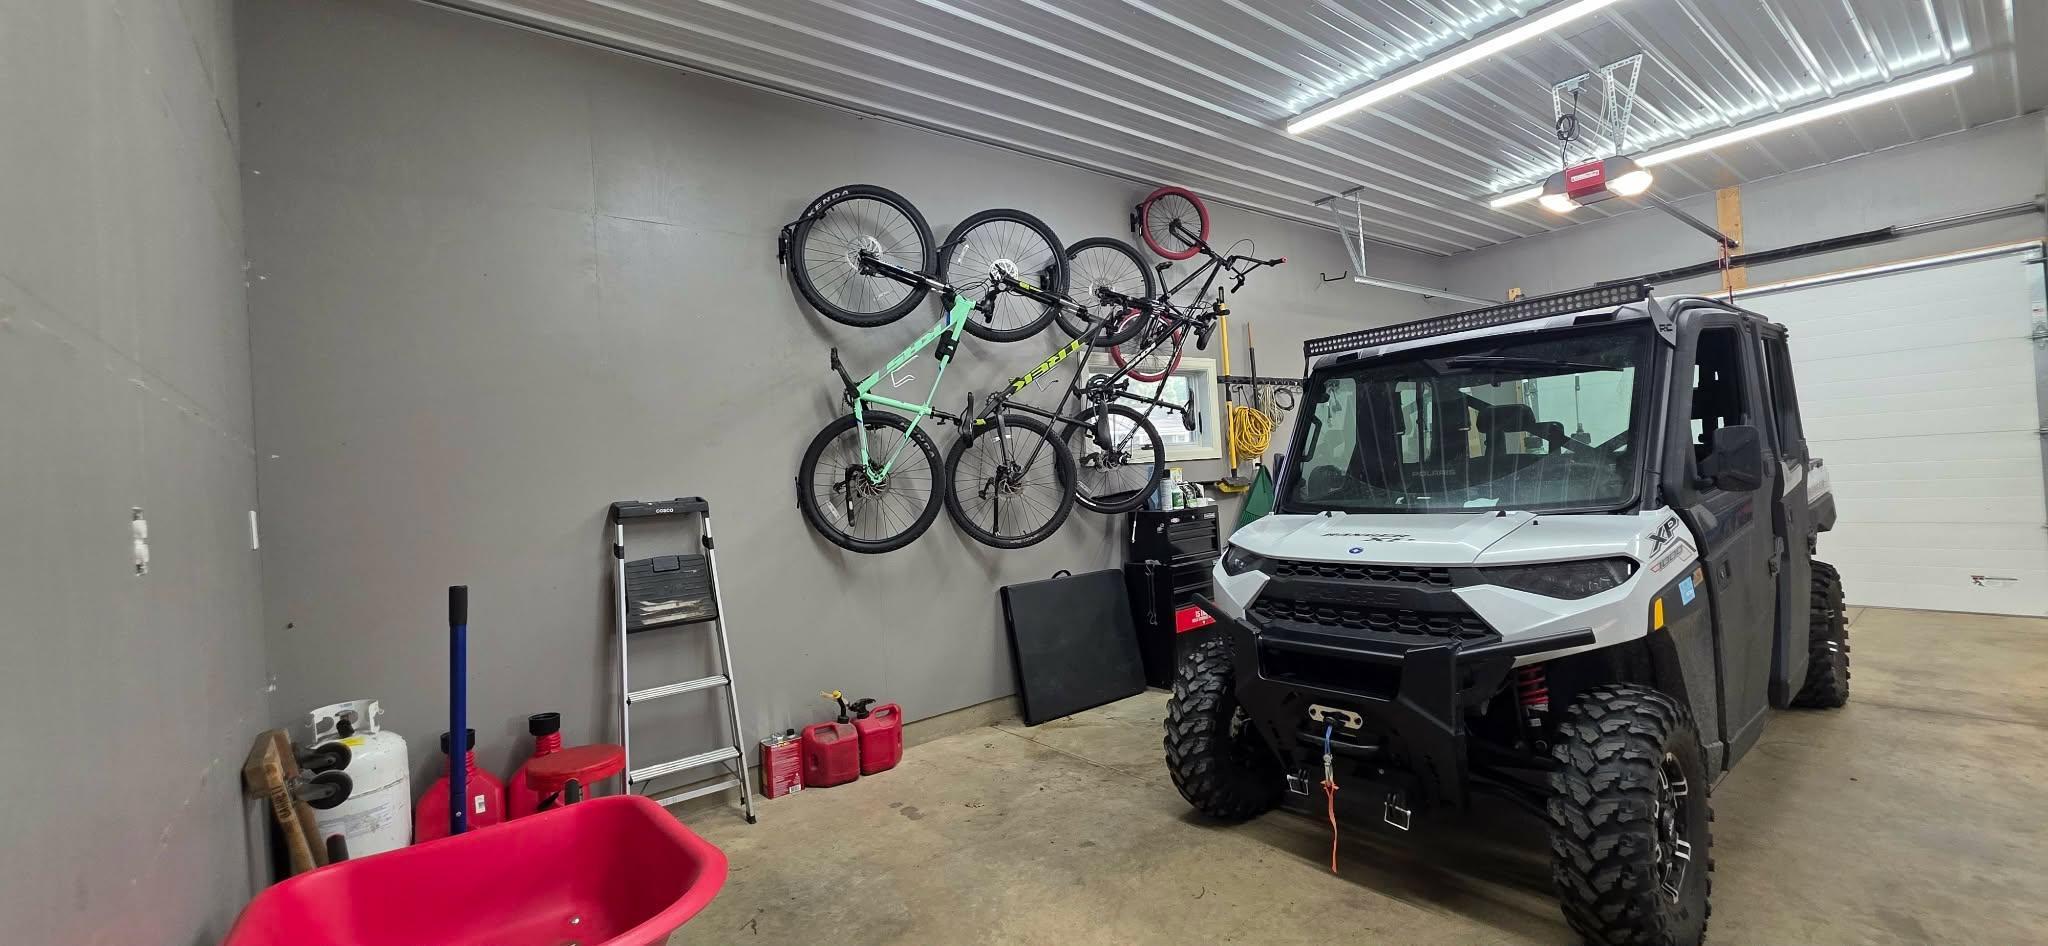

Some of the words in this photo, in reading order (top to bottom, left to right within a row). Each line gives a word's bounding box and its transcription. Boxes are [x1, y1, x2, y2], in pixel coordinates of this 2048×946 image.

[807, 190, 849, 217] KENDA
[1659, 323, 1673, 332] RC
[1012, 339, 1087, 392] TREK
[899, 421, 936, 459] KNDA
[1411, 469, 1457, 478] POLARIS
[1648, 516, 1678, 556] XP
